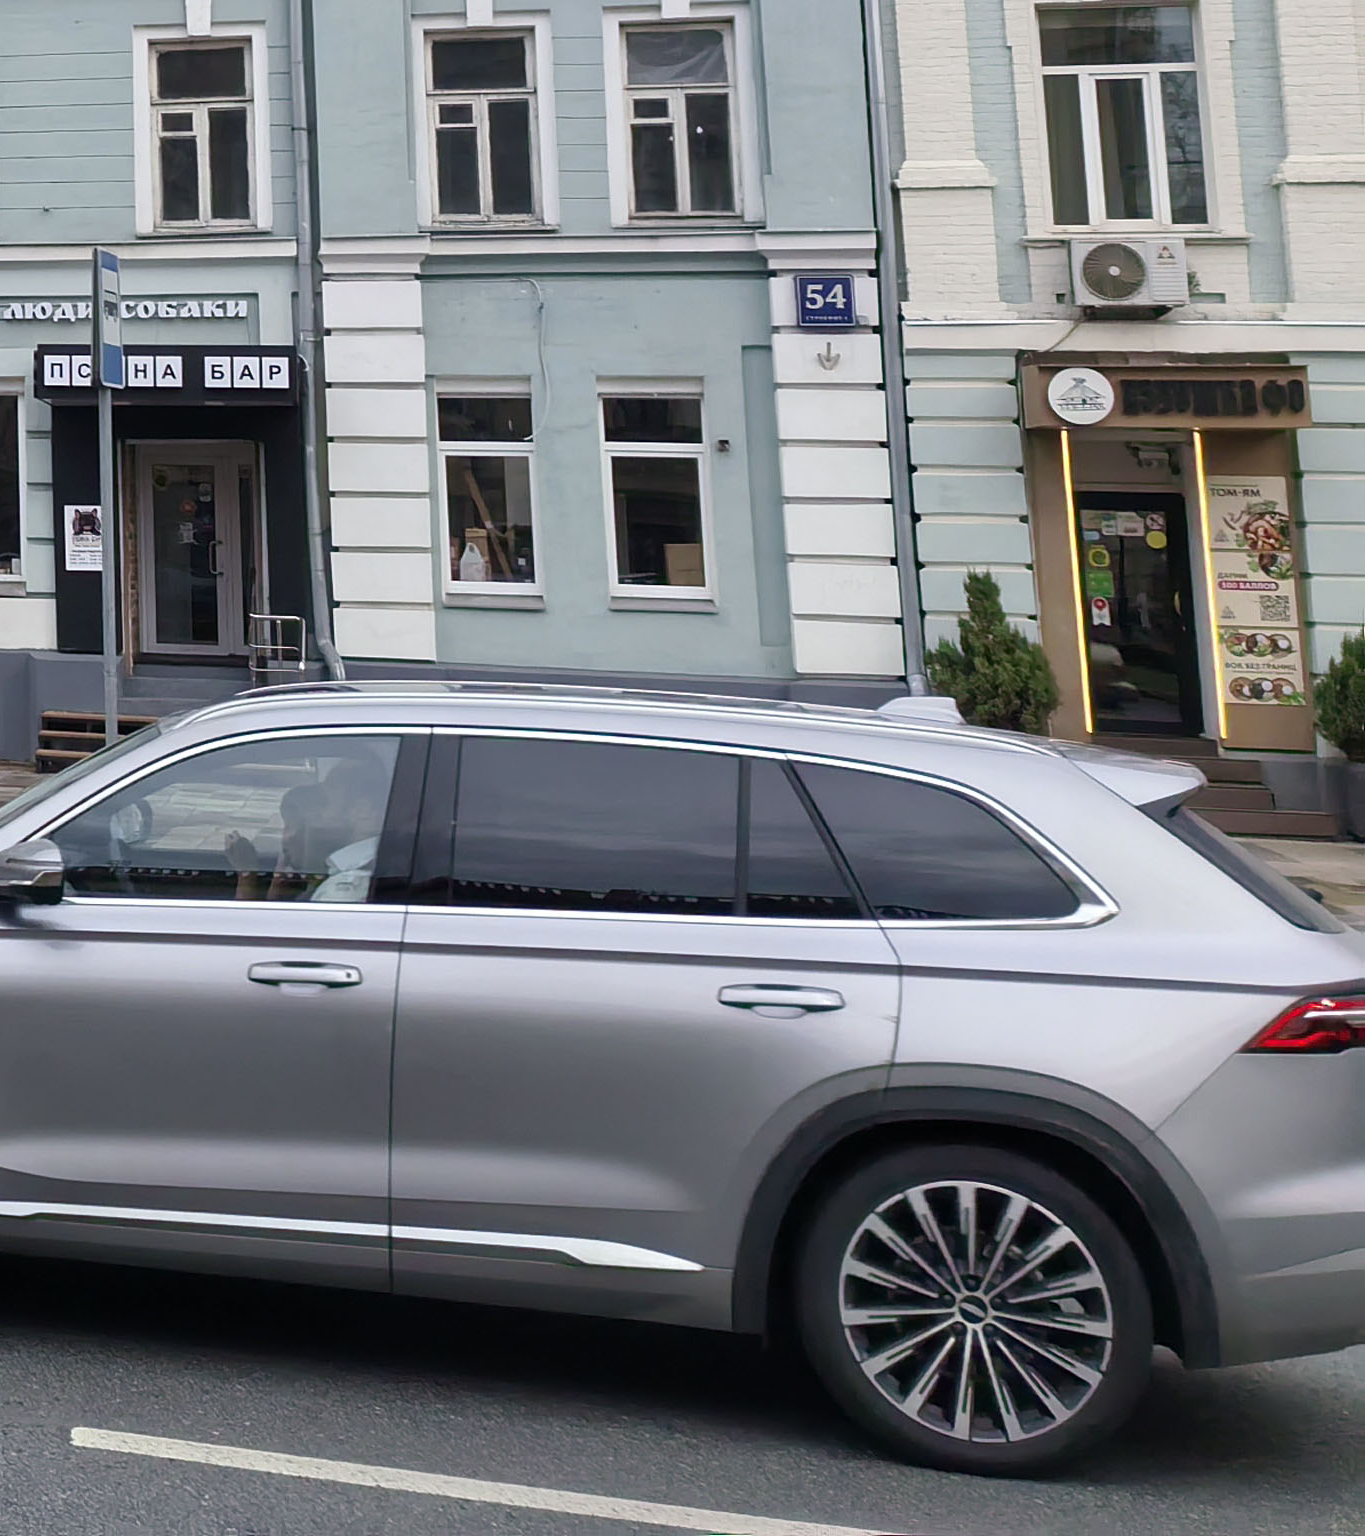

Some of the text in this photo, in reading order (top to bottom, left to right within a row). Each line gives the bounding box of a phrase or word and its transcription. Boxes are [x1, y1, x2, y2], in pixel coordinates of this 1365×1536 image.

[805, 284, 847, 310] 54
[120, 300, 248, 319] СОБАКИ
[49, 362, 282, 381] ПСНА БАР
[1209, 487, 1262, 498] ТОМ-ЯМ
